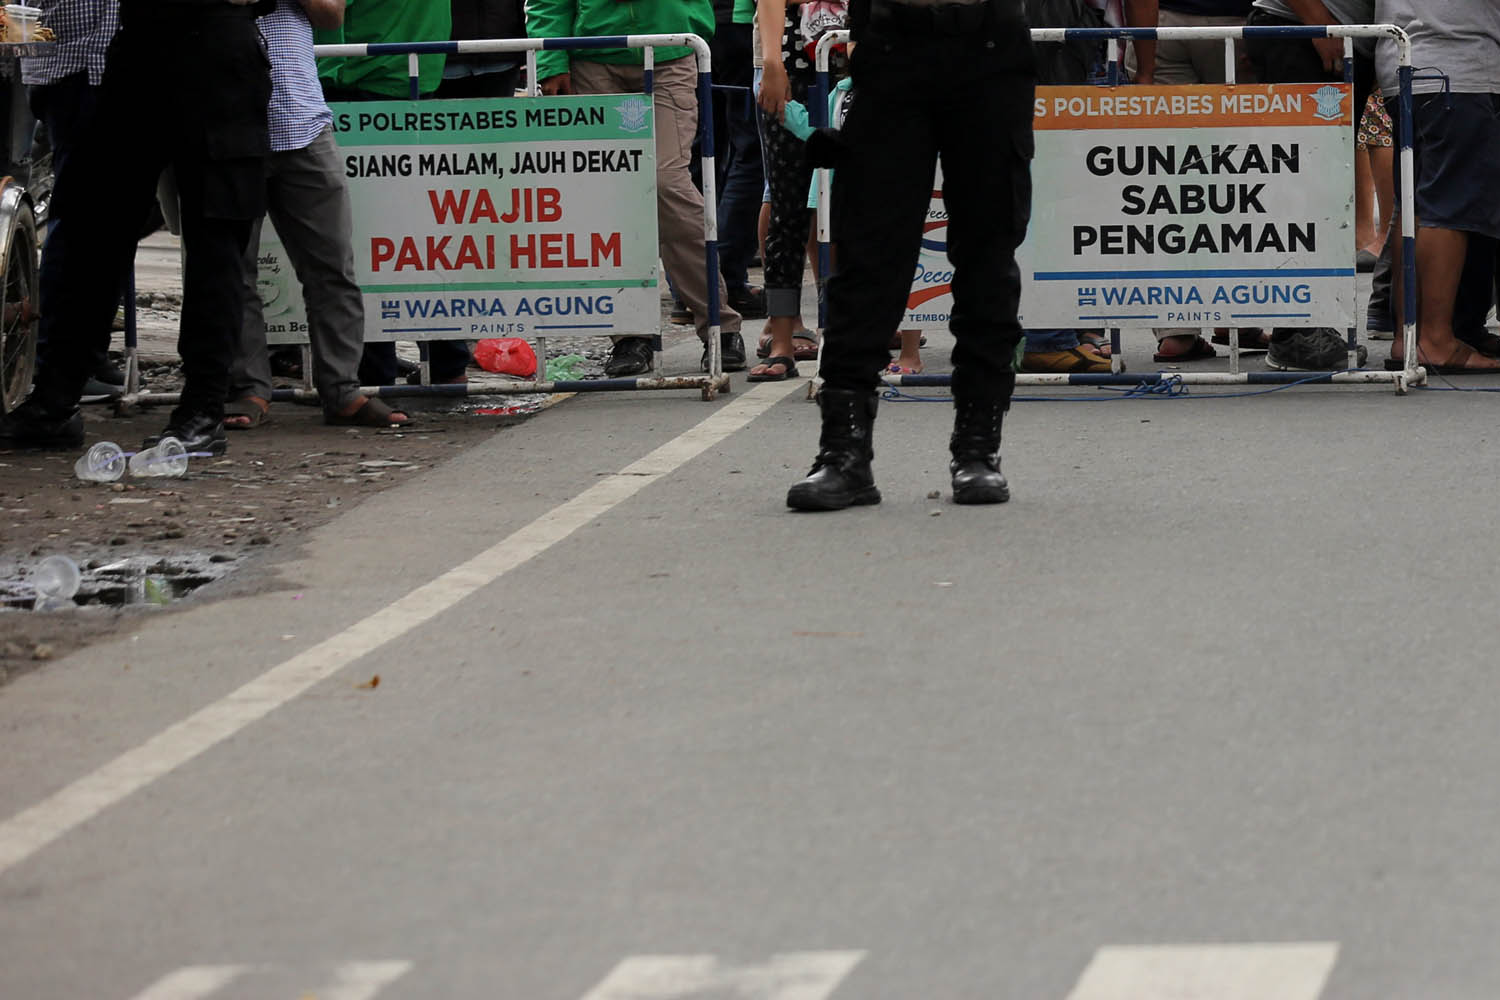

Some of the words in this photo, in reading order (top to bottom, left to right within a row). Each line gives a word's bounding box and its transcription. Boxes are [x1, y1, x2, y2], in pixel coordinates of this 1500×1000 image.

[359, 109, 518, 132] POLRESTABES
[526, 106, 605, 129] MEDAN
[1054, 94, 1213, 117] POLRESTABES
[1221, 93, 1302, 115] MEDAN
[345, 154, 412, 178] SIANG
[419, 152, 504, 179] MALAM,
[510, 151, 566, 175] JAUH
[573, 149, 643, 173] DEKAT
[1086, 143, 1300, 177] GUNAKAN
[427, 187, 563, 225] WAJIB
[1120, 183, 1267, 216] SABUK
[370, 234, 495, 273] PAKAI
[509, 231, 623, 270] HELM
[1072, 222, 1317, 256] PENGAMAN
[405, 297, 507, 318] WARNA
[515, 295, 614, 316] AGUNG
[1101, 285, 1204, 306] WARNA
[1212, 283, 1312, 305] AGUNG
[471, 323, 525, 334] PAINTS
[1167, 311, 1222, 322] PAINTS
